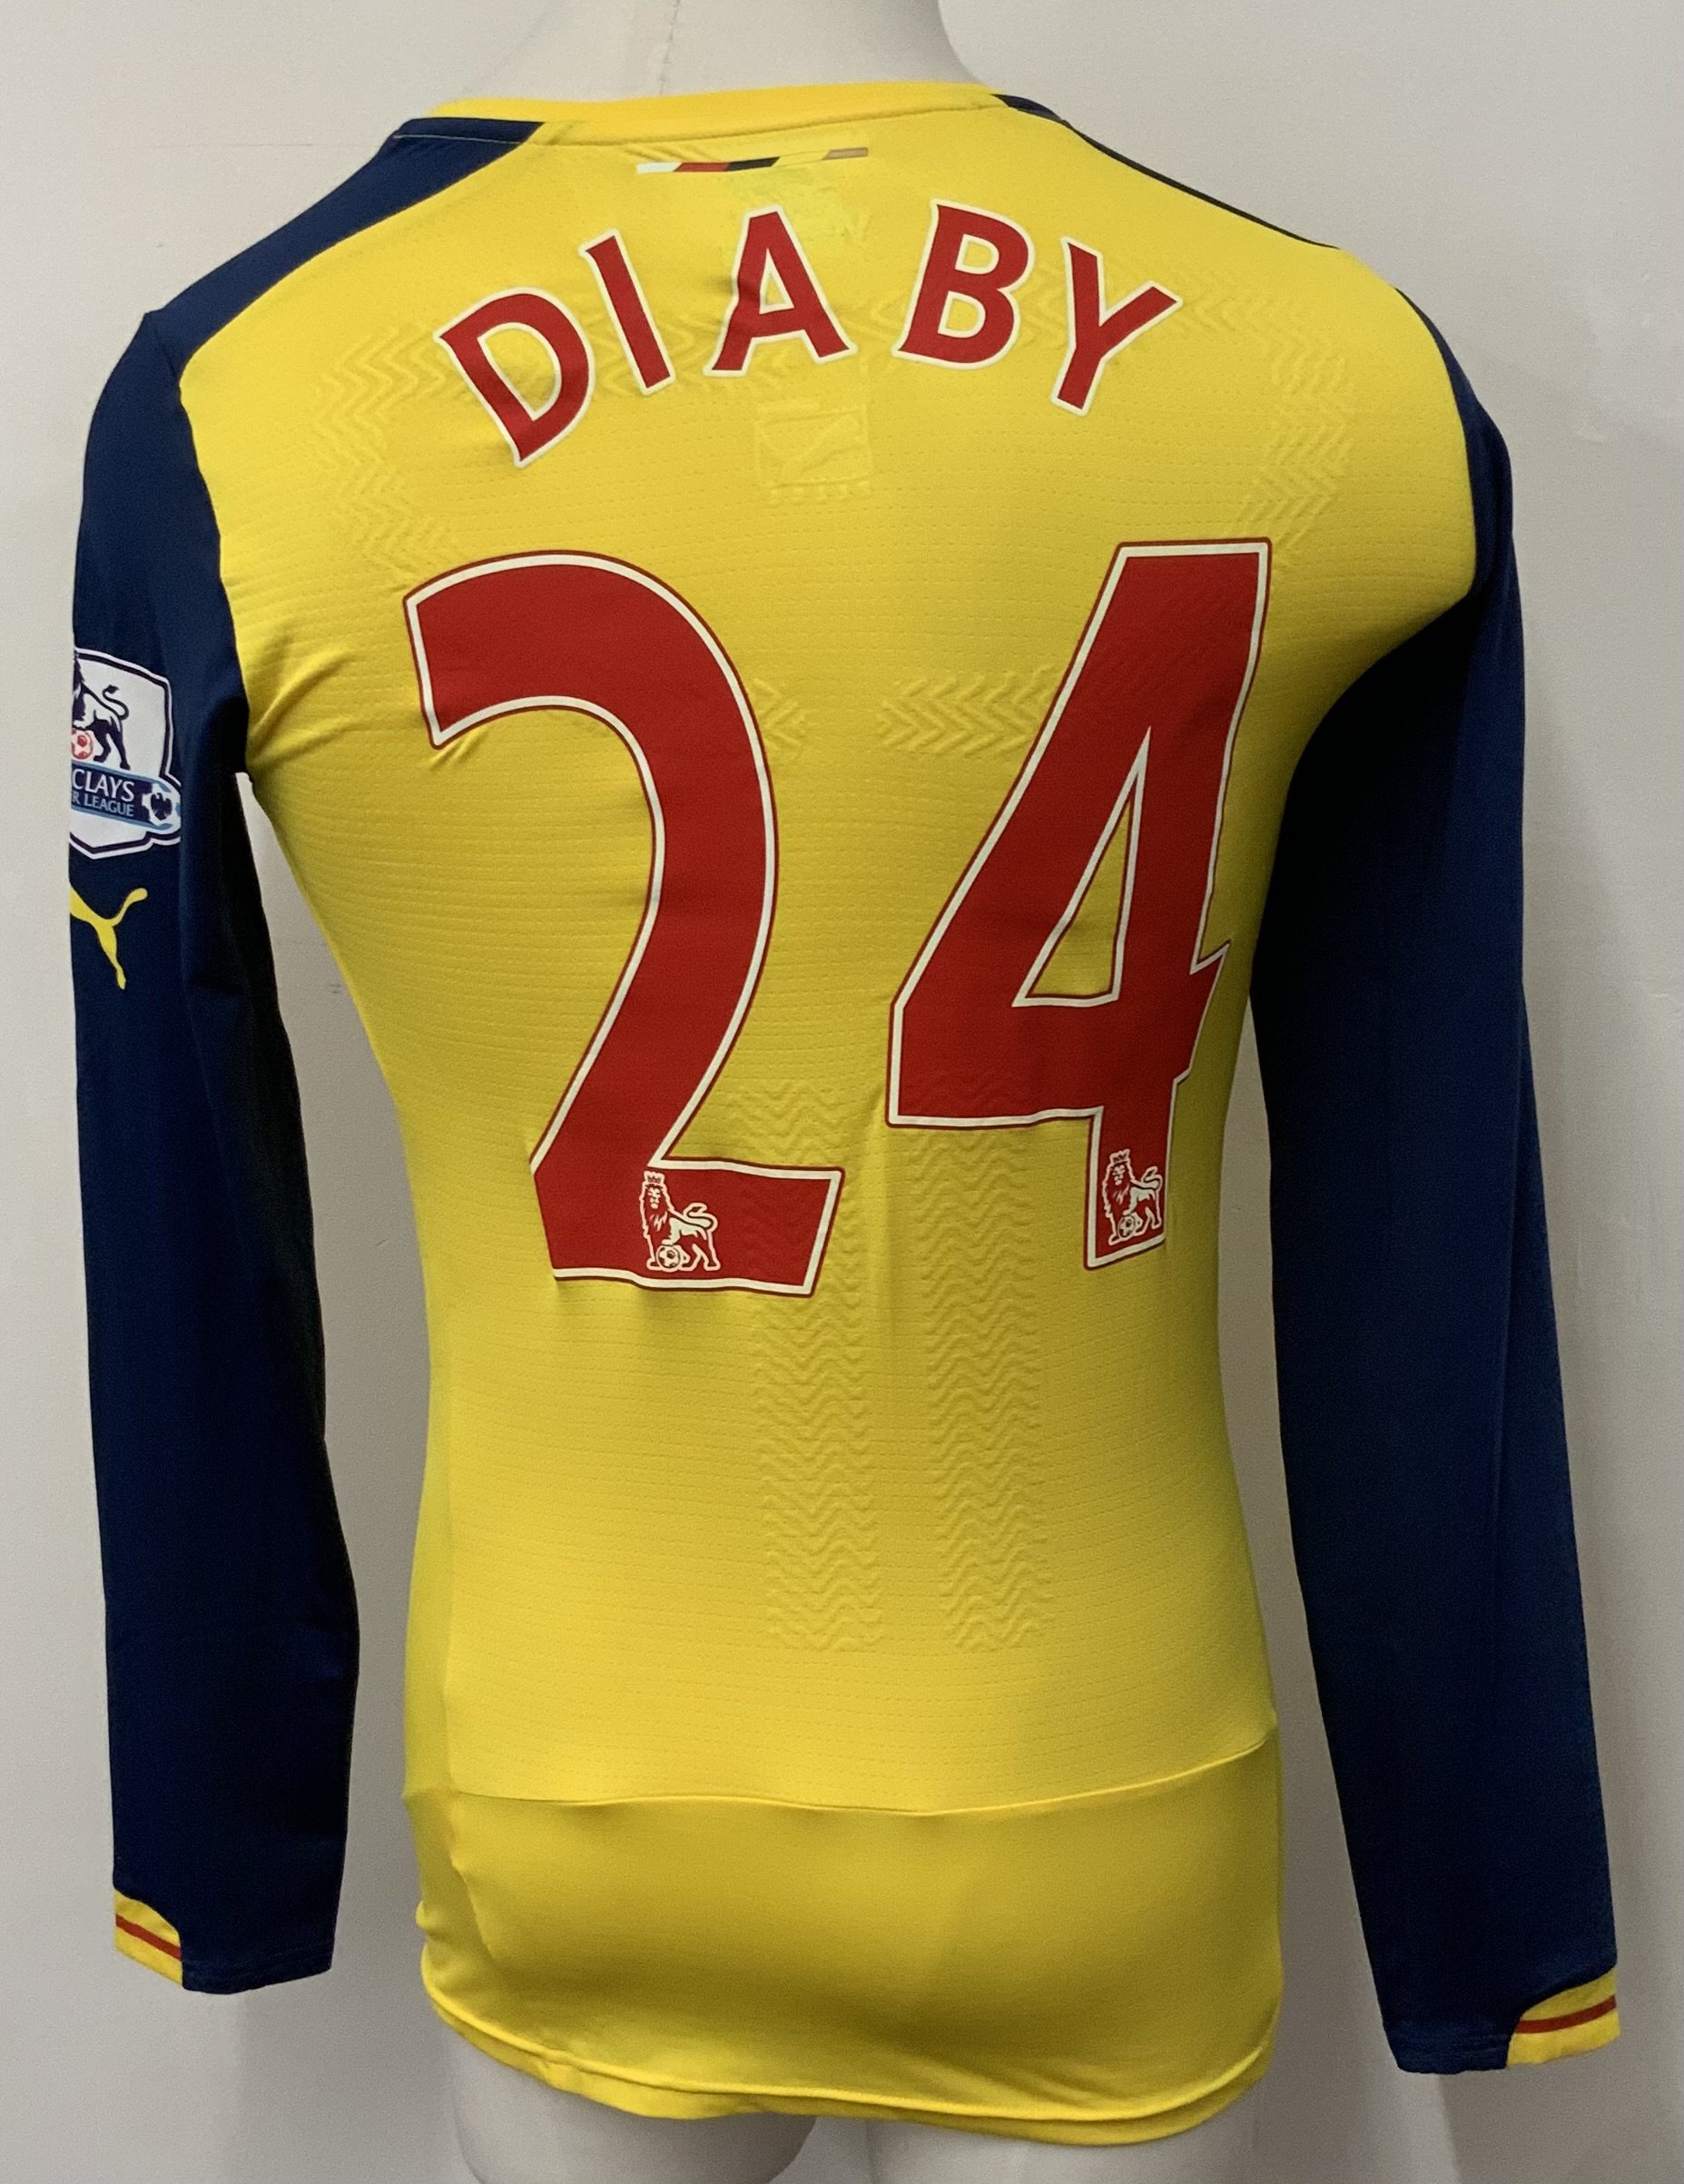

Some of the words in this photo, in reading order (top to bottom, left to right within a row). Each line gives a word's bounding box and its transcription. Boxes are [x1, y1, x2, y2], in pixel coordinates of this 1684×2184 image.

[434, 199, 1183, 467] DIABY
[72, 768, 135, 802] CLAYS
[84, 793, 134, 817] LEAGUE
[403, 537, 1271, 1296] 24
